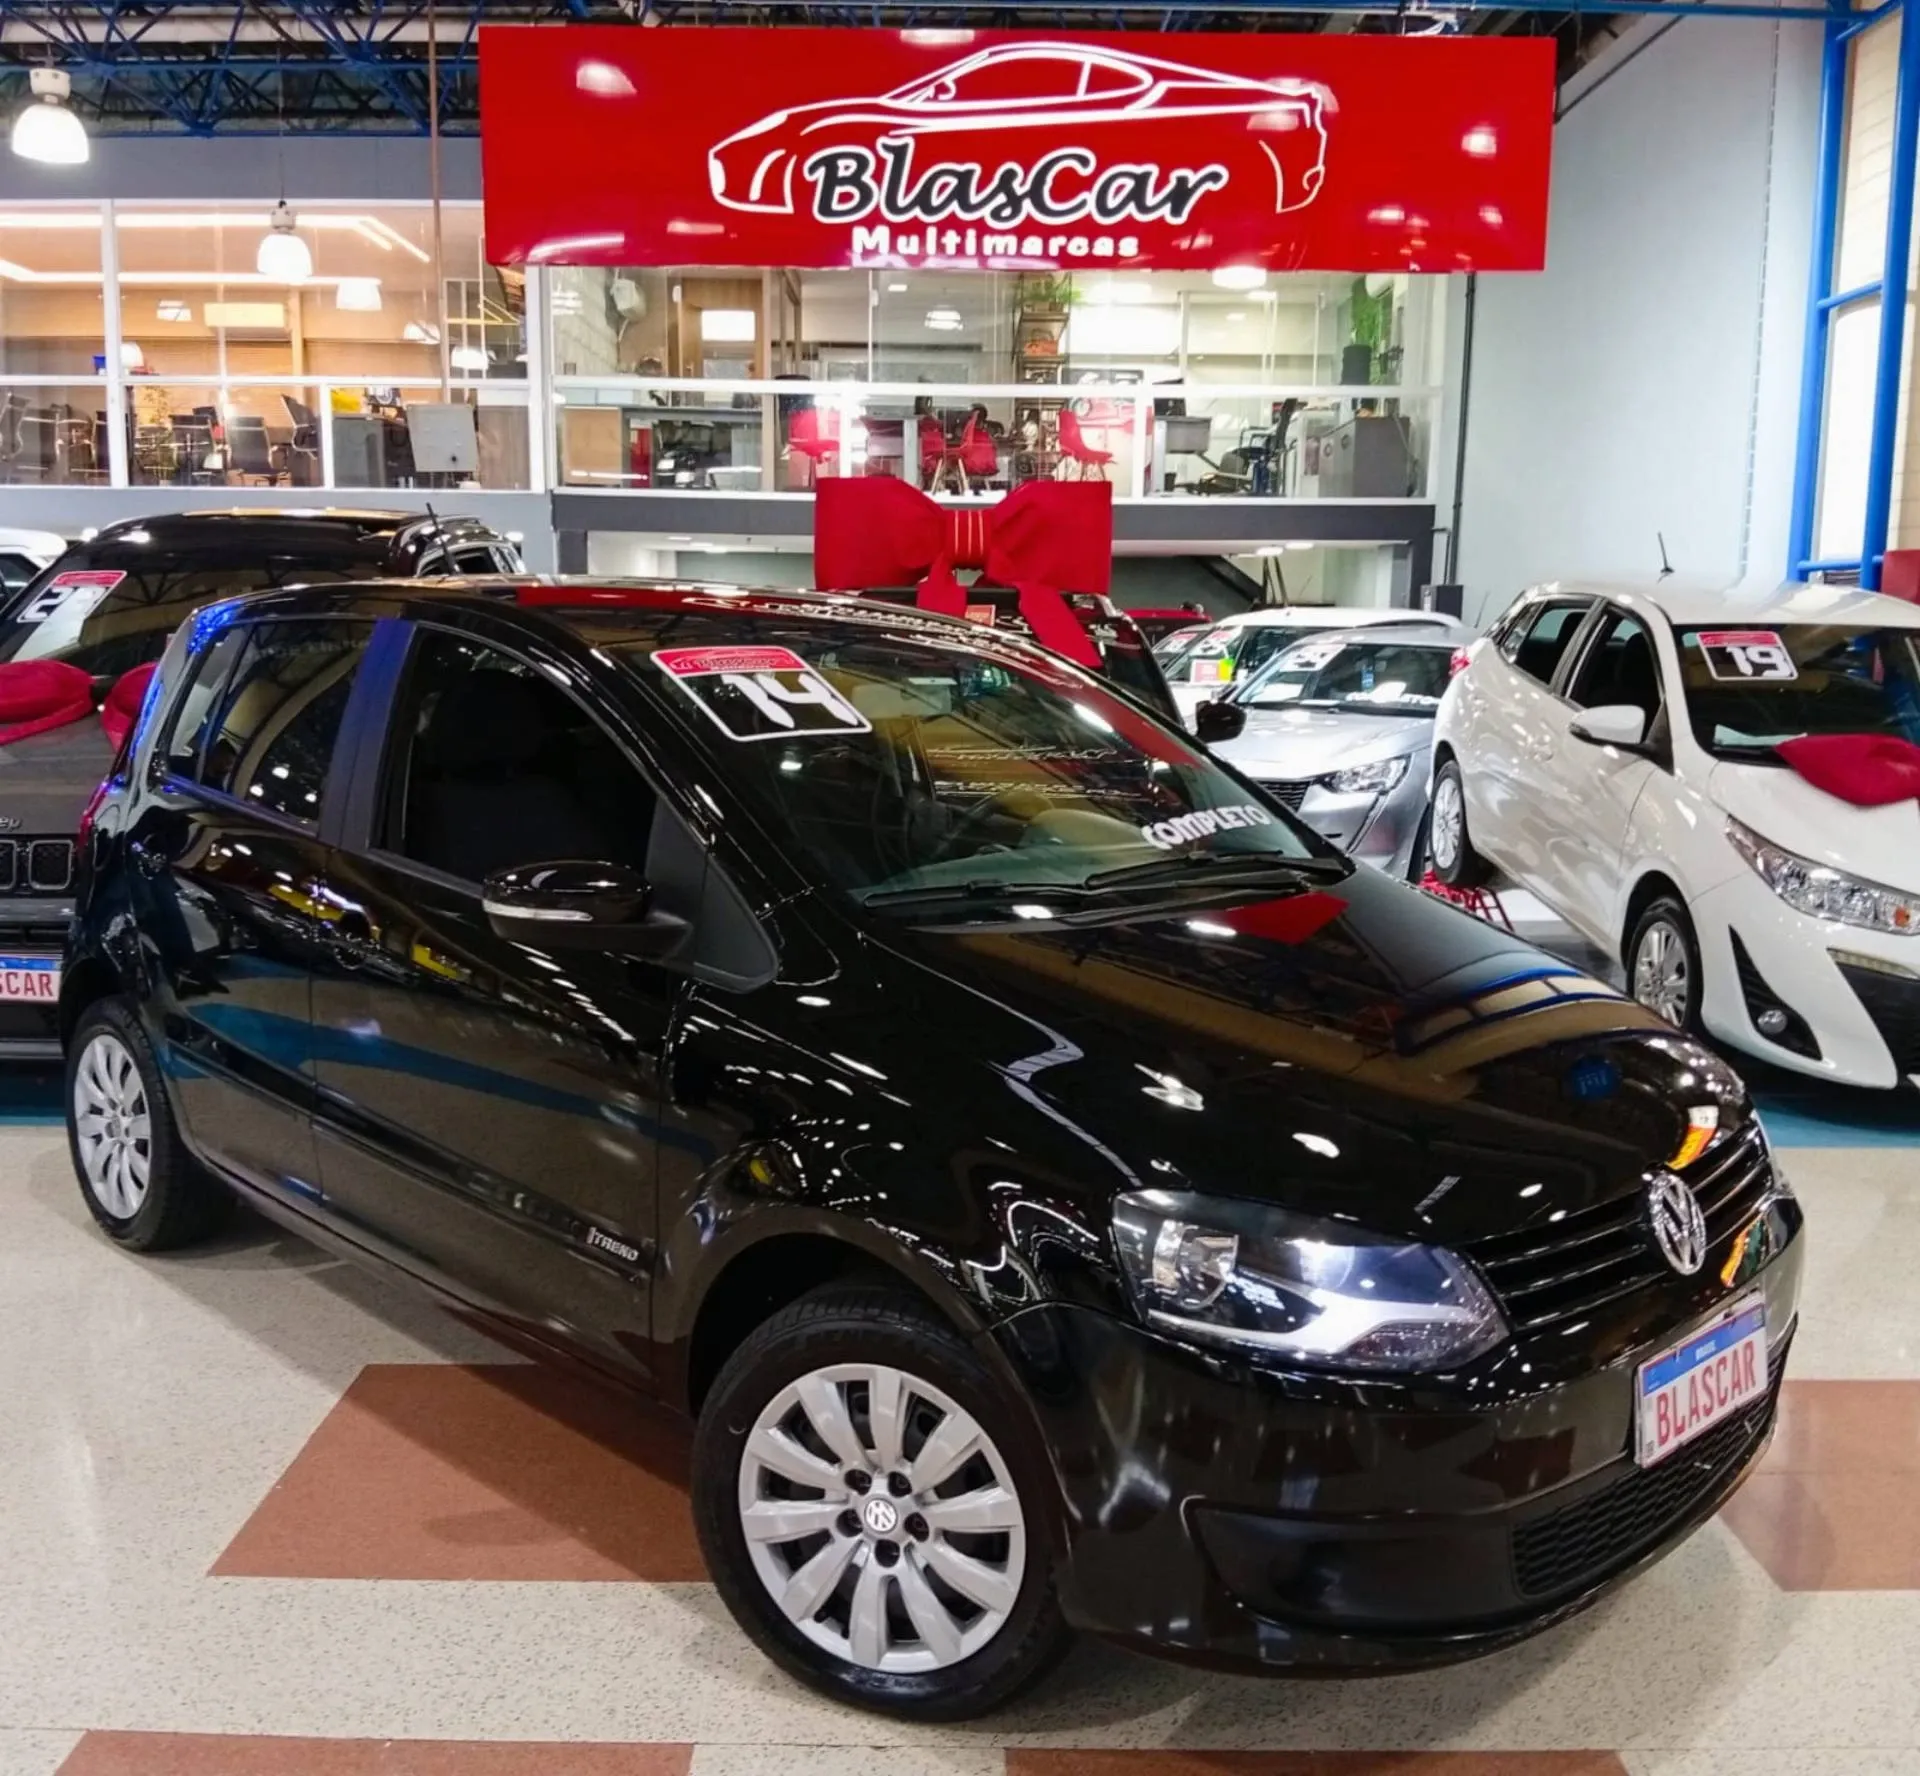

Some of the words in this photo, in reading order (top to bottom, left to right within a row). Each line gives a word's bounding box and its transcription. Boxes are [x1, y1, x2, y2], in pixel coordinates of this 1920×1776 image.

[804, 137, 1229, 229] BlasCar
[853, 225, 1140, 258] Multimarcas
[1726, 647, 1792, 677] 19
[721, 673, 859, 729] 14
[1141, 804, 1271, 850] COMPLETO
[1656, 1340, 1757, 1447] BLASCAR
